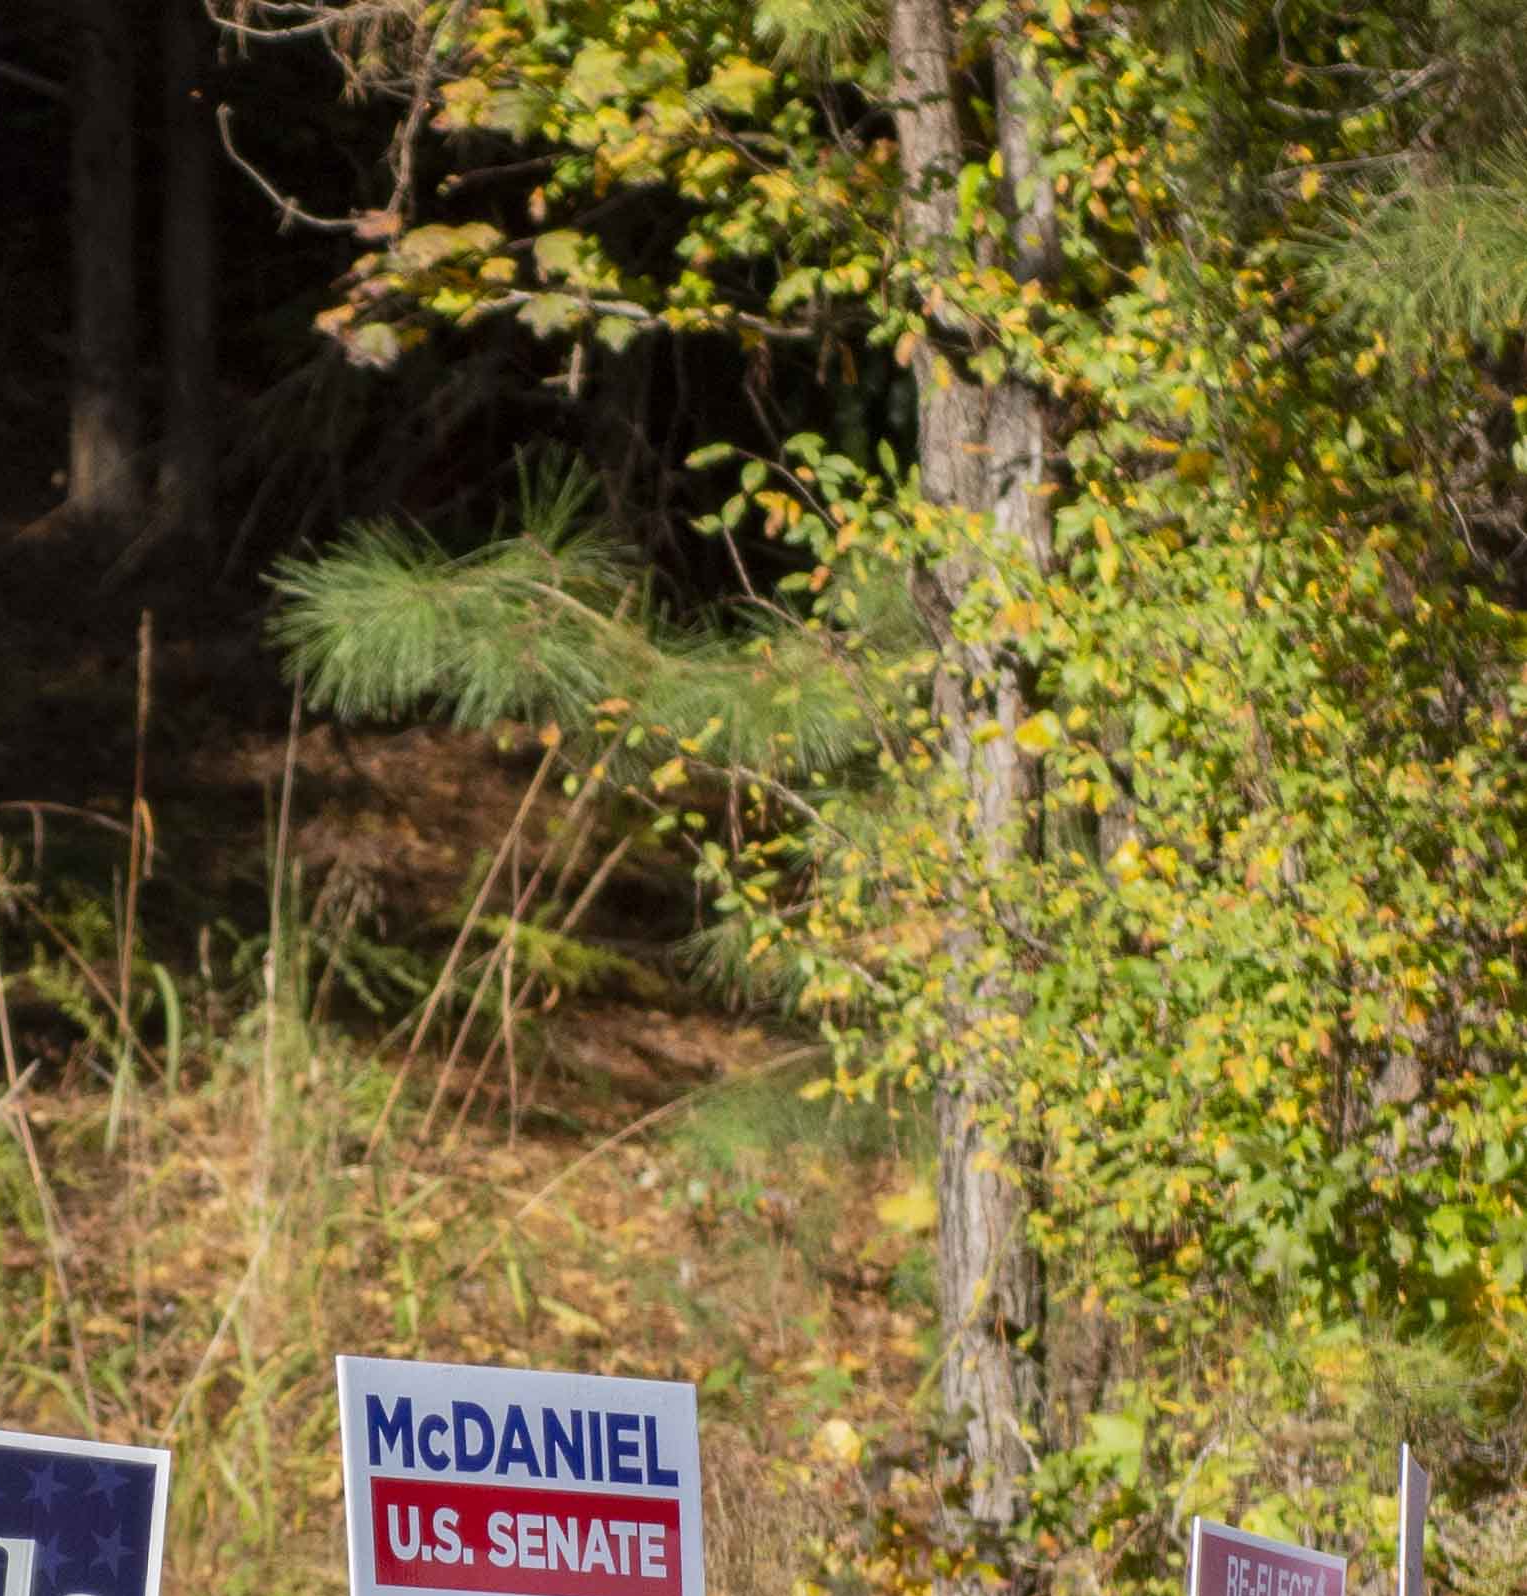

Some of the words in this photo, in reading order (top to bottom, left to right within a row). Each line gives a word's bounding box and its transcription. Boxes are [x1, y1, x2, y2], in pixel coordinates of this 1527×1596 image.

[365, 1394, 679, 1487] McDANIEL
[387, 1504, 475, 1565] U.S.
[487, 1511, 668, 1579] SENATE
